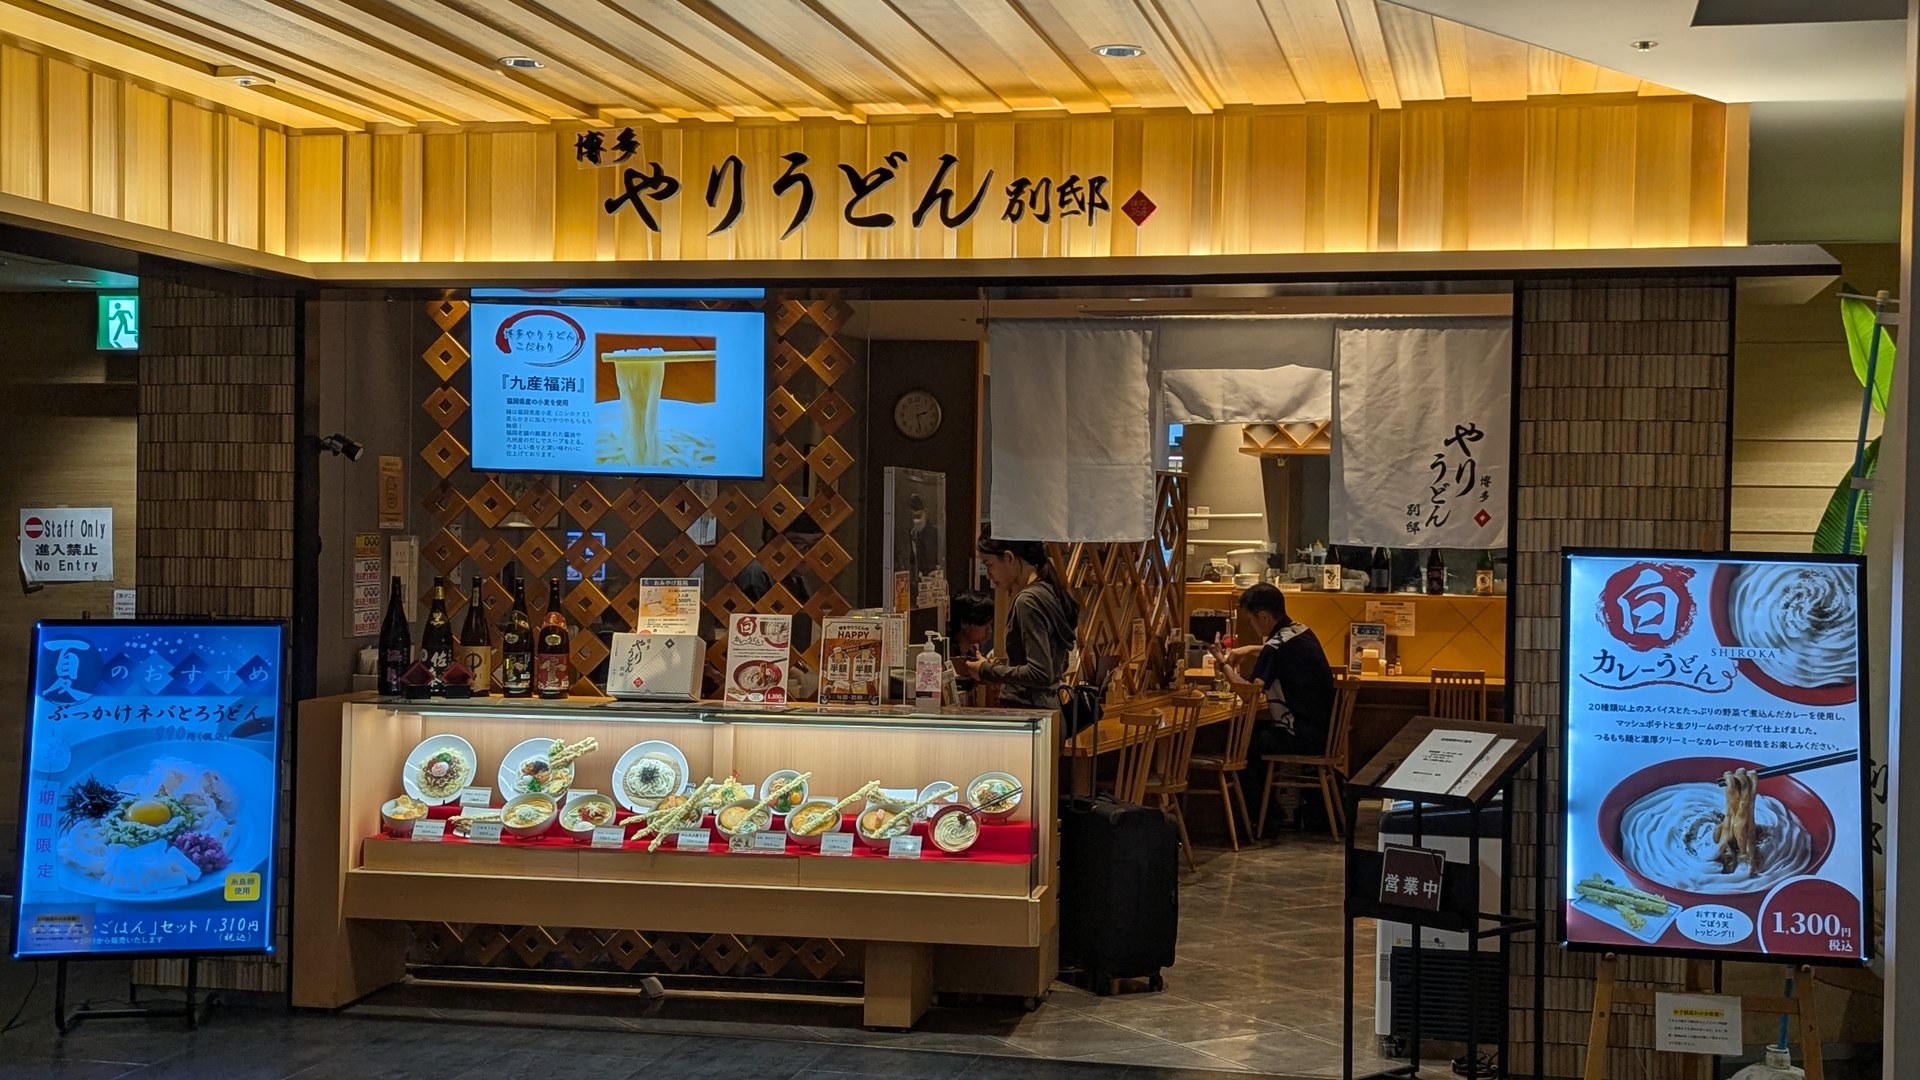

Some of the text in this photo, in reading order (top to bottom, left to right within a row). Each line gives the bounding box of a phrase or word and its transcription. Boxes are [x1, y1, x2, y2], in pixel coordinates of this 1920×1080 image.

[574, 126, 641, 165] 博多
[604, 150, 1111, 241] やりうどん 別邸
[505, 328, 575, 341] 博多やりうどん
[515, 342, 554, 353] こだわり
[502, 373, 585, 393] 『九産福消』
[44, 518, 106, 540] Staff Only
[35, 543, 98, 557] 進入禁止
[34, 559, 98, 572] No Entry
[837, 631, 870, 639] HAPPY
[1711, 647, 1776, 660] SHIROKA
[830, 664, 848, 673] 半額
[855, 664, 873, 674] 半額
[1589, 648, 1718, 686] カレーうどん
[48, 703, 262, 723] ぶっかけネバとろうどん
[1588, 702, 1847, 722] 20種類以上のスパイスとたっぷりの野菜で煮込んだカレーを使用し、
[1615, 719, 1818, 736] マッシュポテトと生クリームのホイップで仕上げました。
[1594, 733, 1841, 752] つるもち麺と濃厚クリーミーなカレーとの相性をお楽しみください。
[36, 789, 56, 879] 期間限定
[1384, 872, 1439, 899] 営業中
[1695, 910, 1734, 919] おすすめは
[204, 918, 259, 933] 1,310円
[1700, 919, 1730, 929] ごぼう天
[1773, 911, 1852, 938] 1,300円
[1827, 938, 1854, 953] 税込
